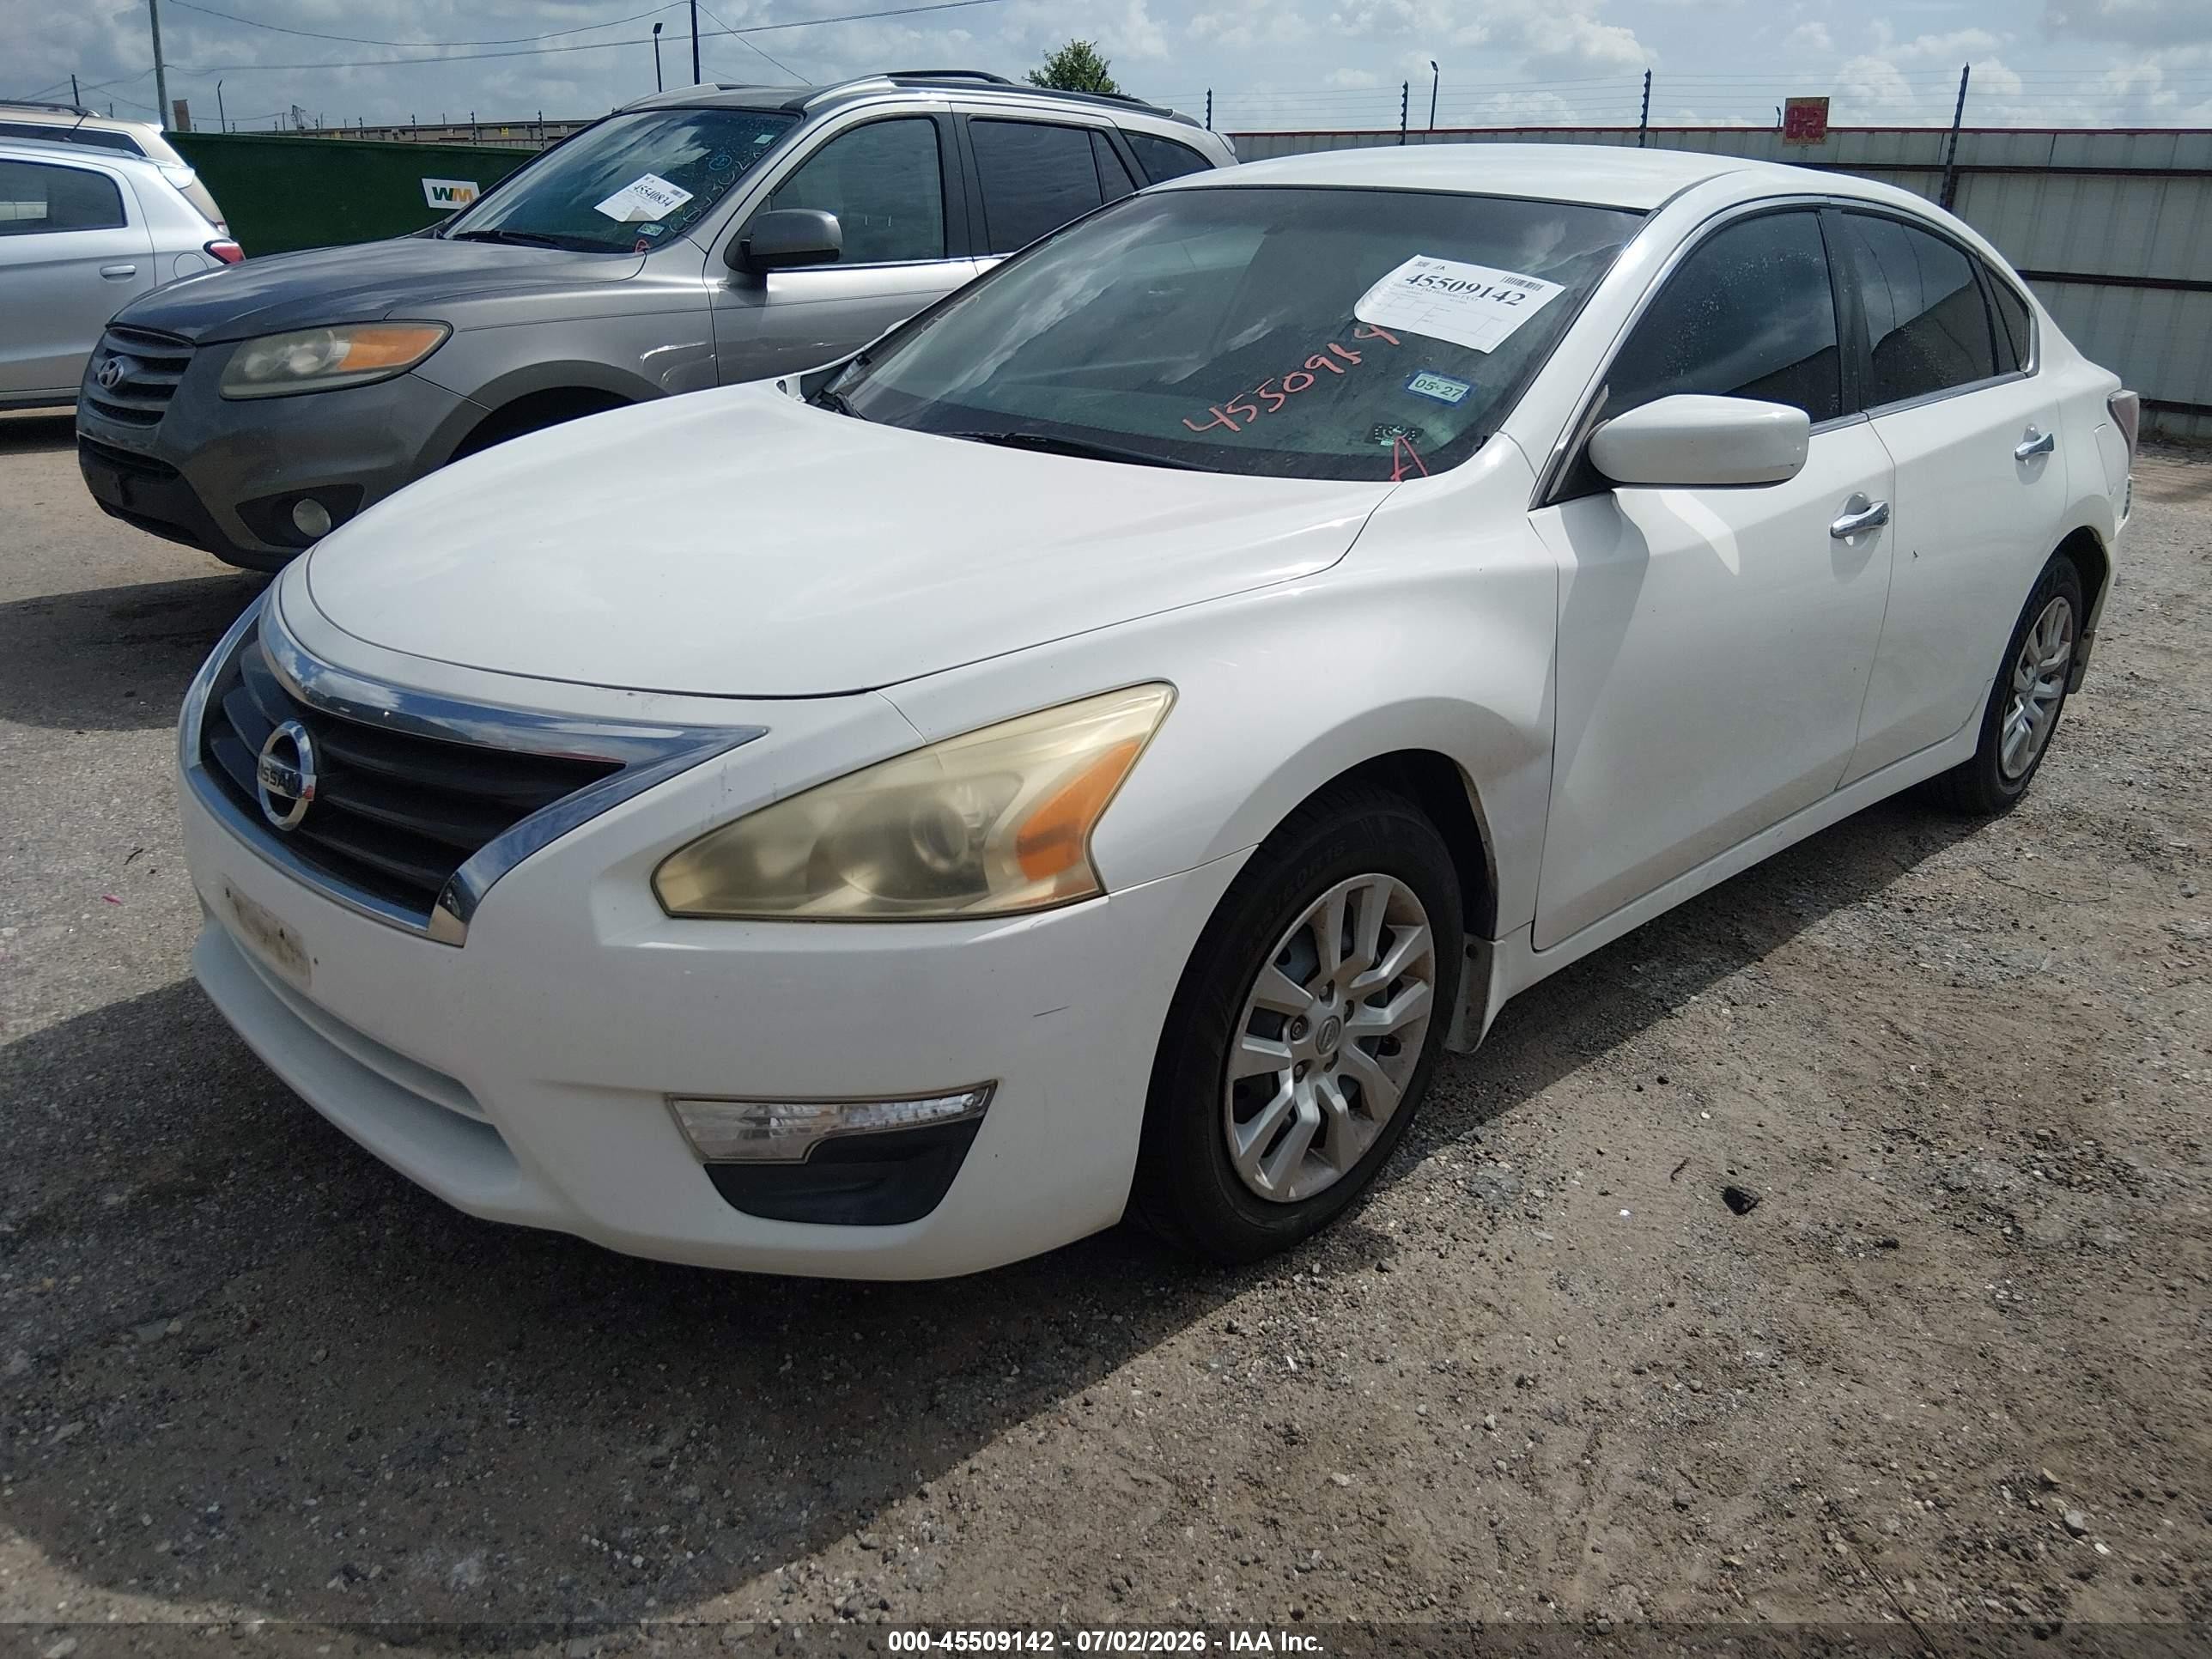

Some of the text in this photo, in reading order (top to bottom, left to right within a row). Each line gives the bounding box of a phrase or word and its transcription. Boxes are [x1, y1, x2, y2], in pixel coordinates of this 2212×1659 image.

[431, 186, 474, 203] WM
[1405, 273, 1527, 307] 45509142
[1414, 379, 1437, 392] 05
[1440, 386, 1464, 398] 27
